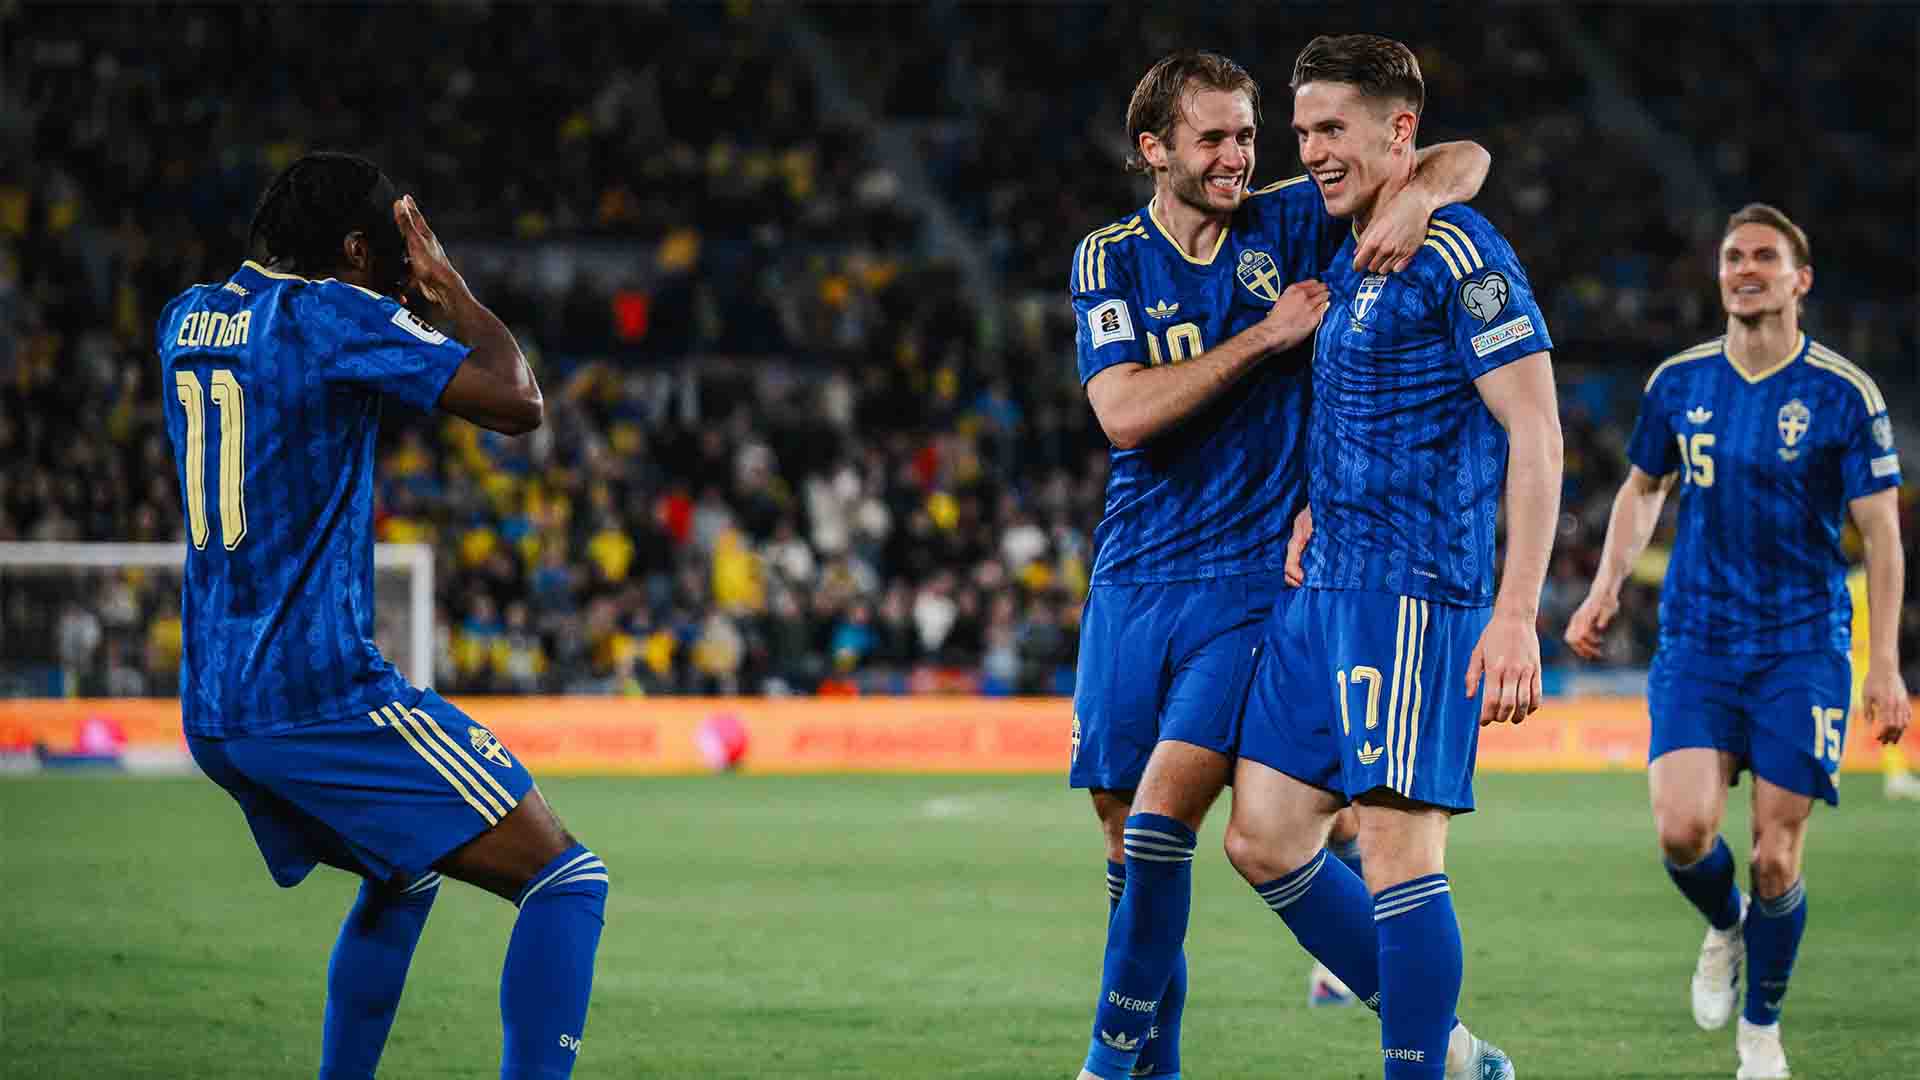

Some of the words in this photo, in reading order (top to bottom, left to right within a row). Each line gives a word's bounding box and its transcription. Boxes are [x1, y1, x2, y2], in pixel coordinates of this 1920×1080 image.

[177, 310, 252, 347] ELANGA
[175, 369, 248, 551] 11
[1677, 433, 1717, 488] 15
[1336, 665, 1384, 737] 17
[1811, 705, 1845, 761] 15
[1381, 1049, 1425, 1063] VERIGE
